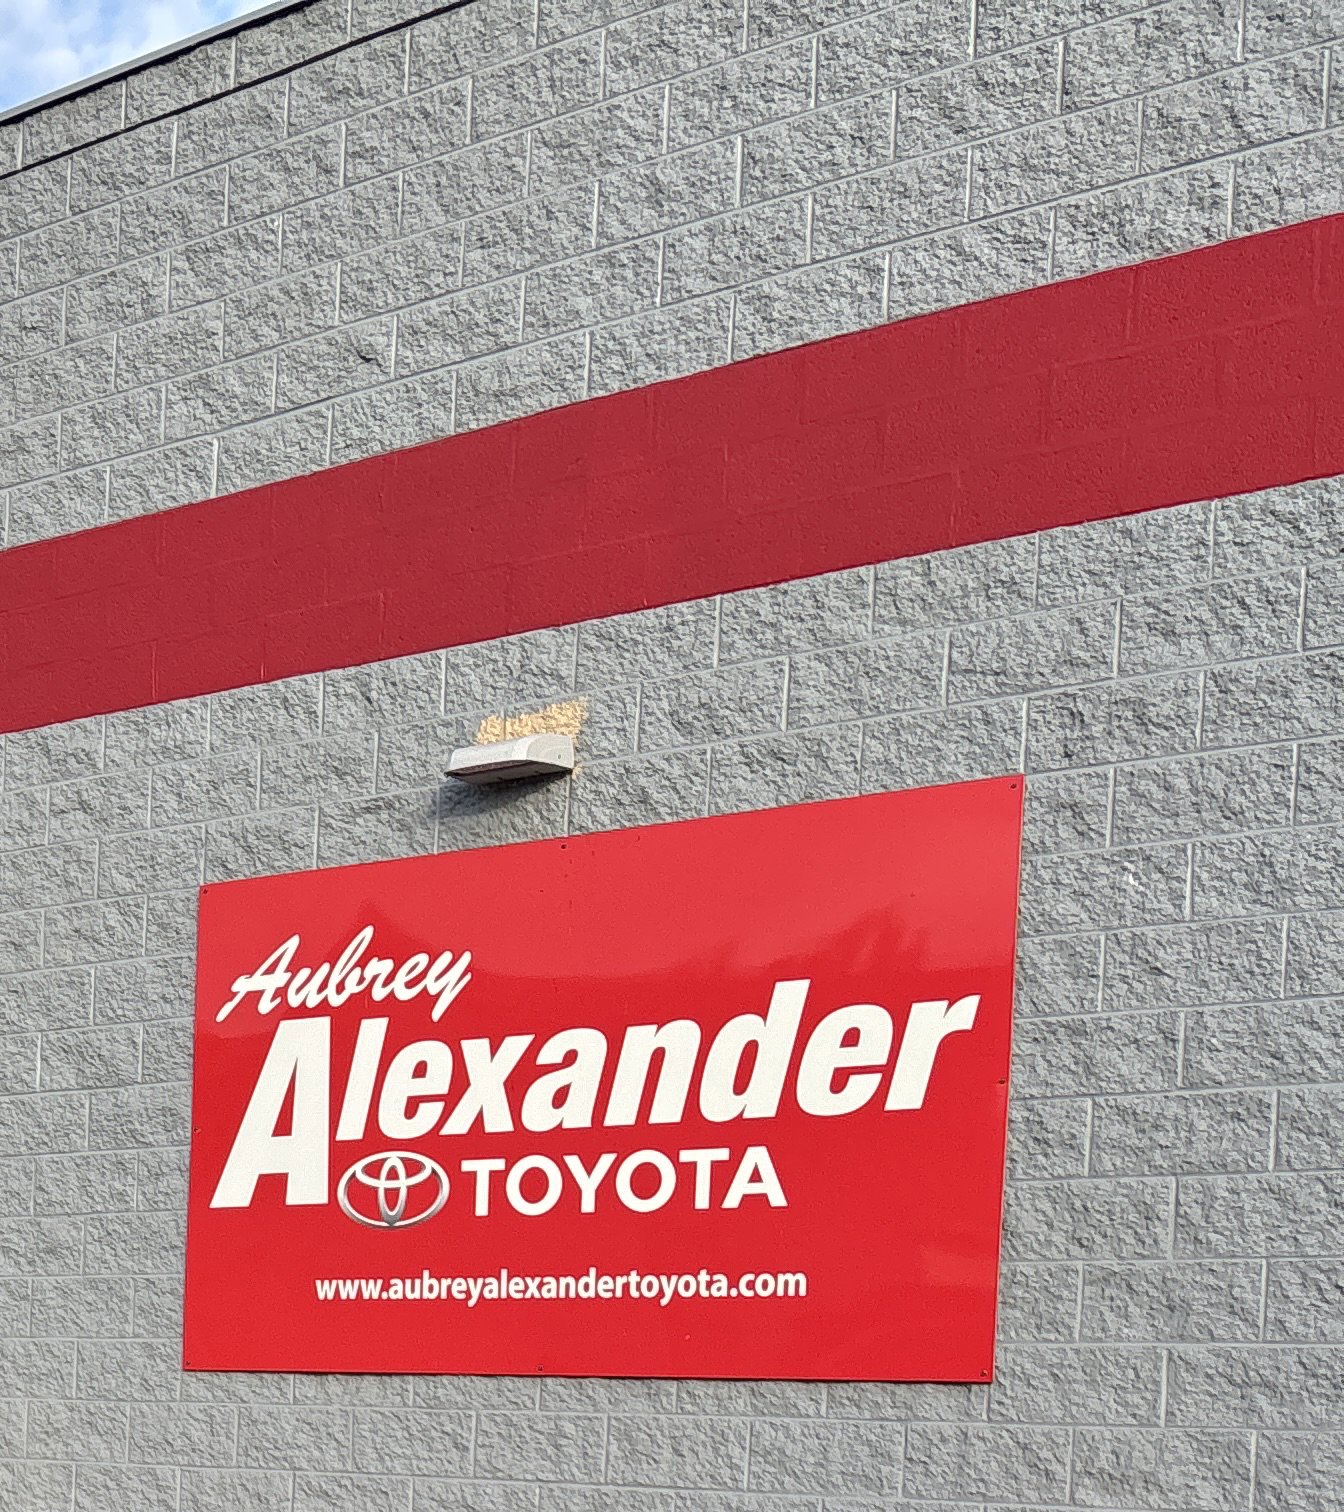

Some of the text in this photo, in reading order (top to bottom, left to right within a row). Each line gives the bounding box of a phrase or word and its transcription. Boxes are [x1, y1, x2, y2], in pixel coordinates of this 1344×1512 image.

[215, 925, 472, 1023] Aubrey
[209, 978, 981, 1209] Alexander
[460, 1145, 788, 1217] TOYOTA
[315, 1266, 807, 1308] www.aubreyalexandertoyota.com
